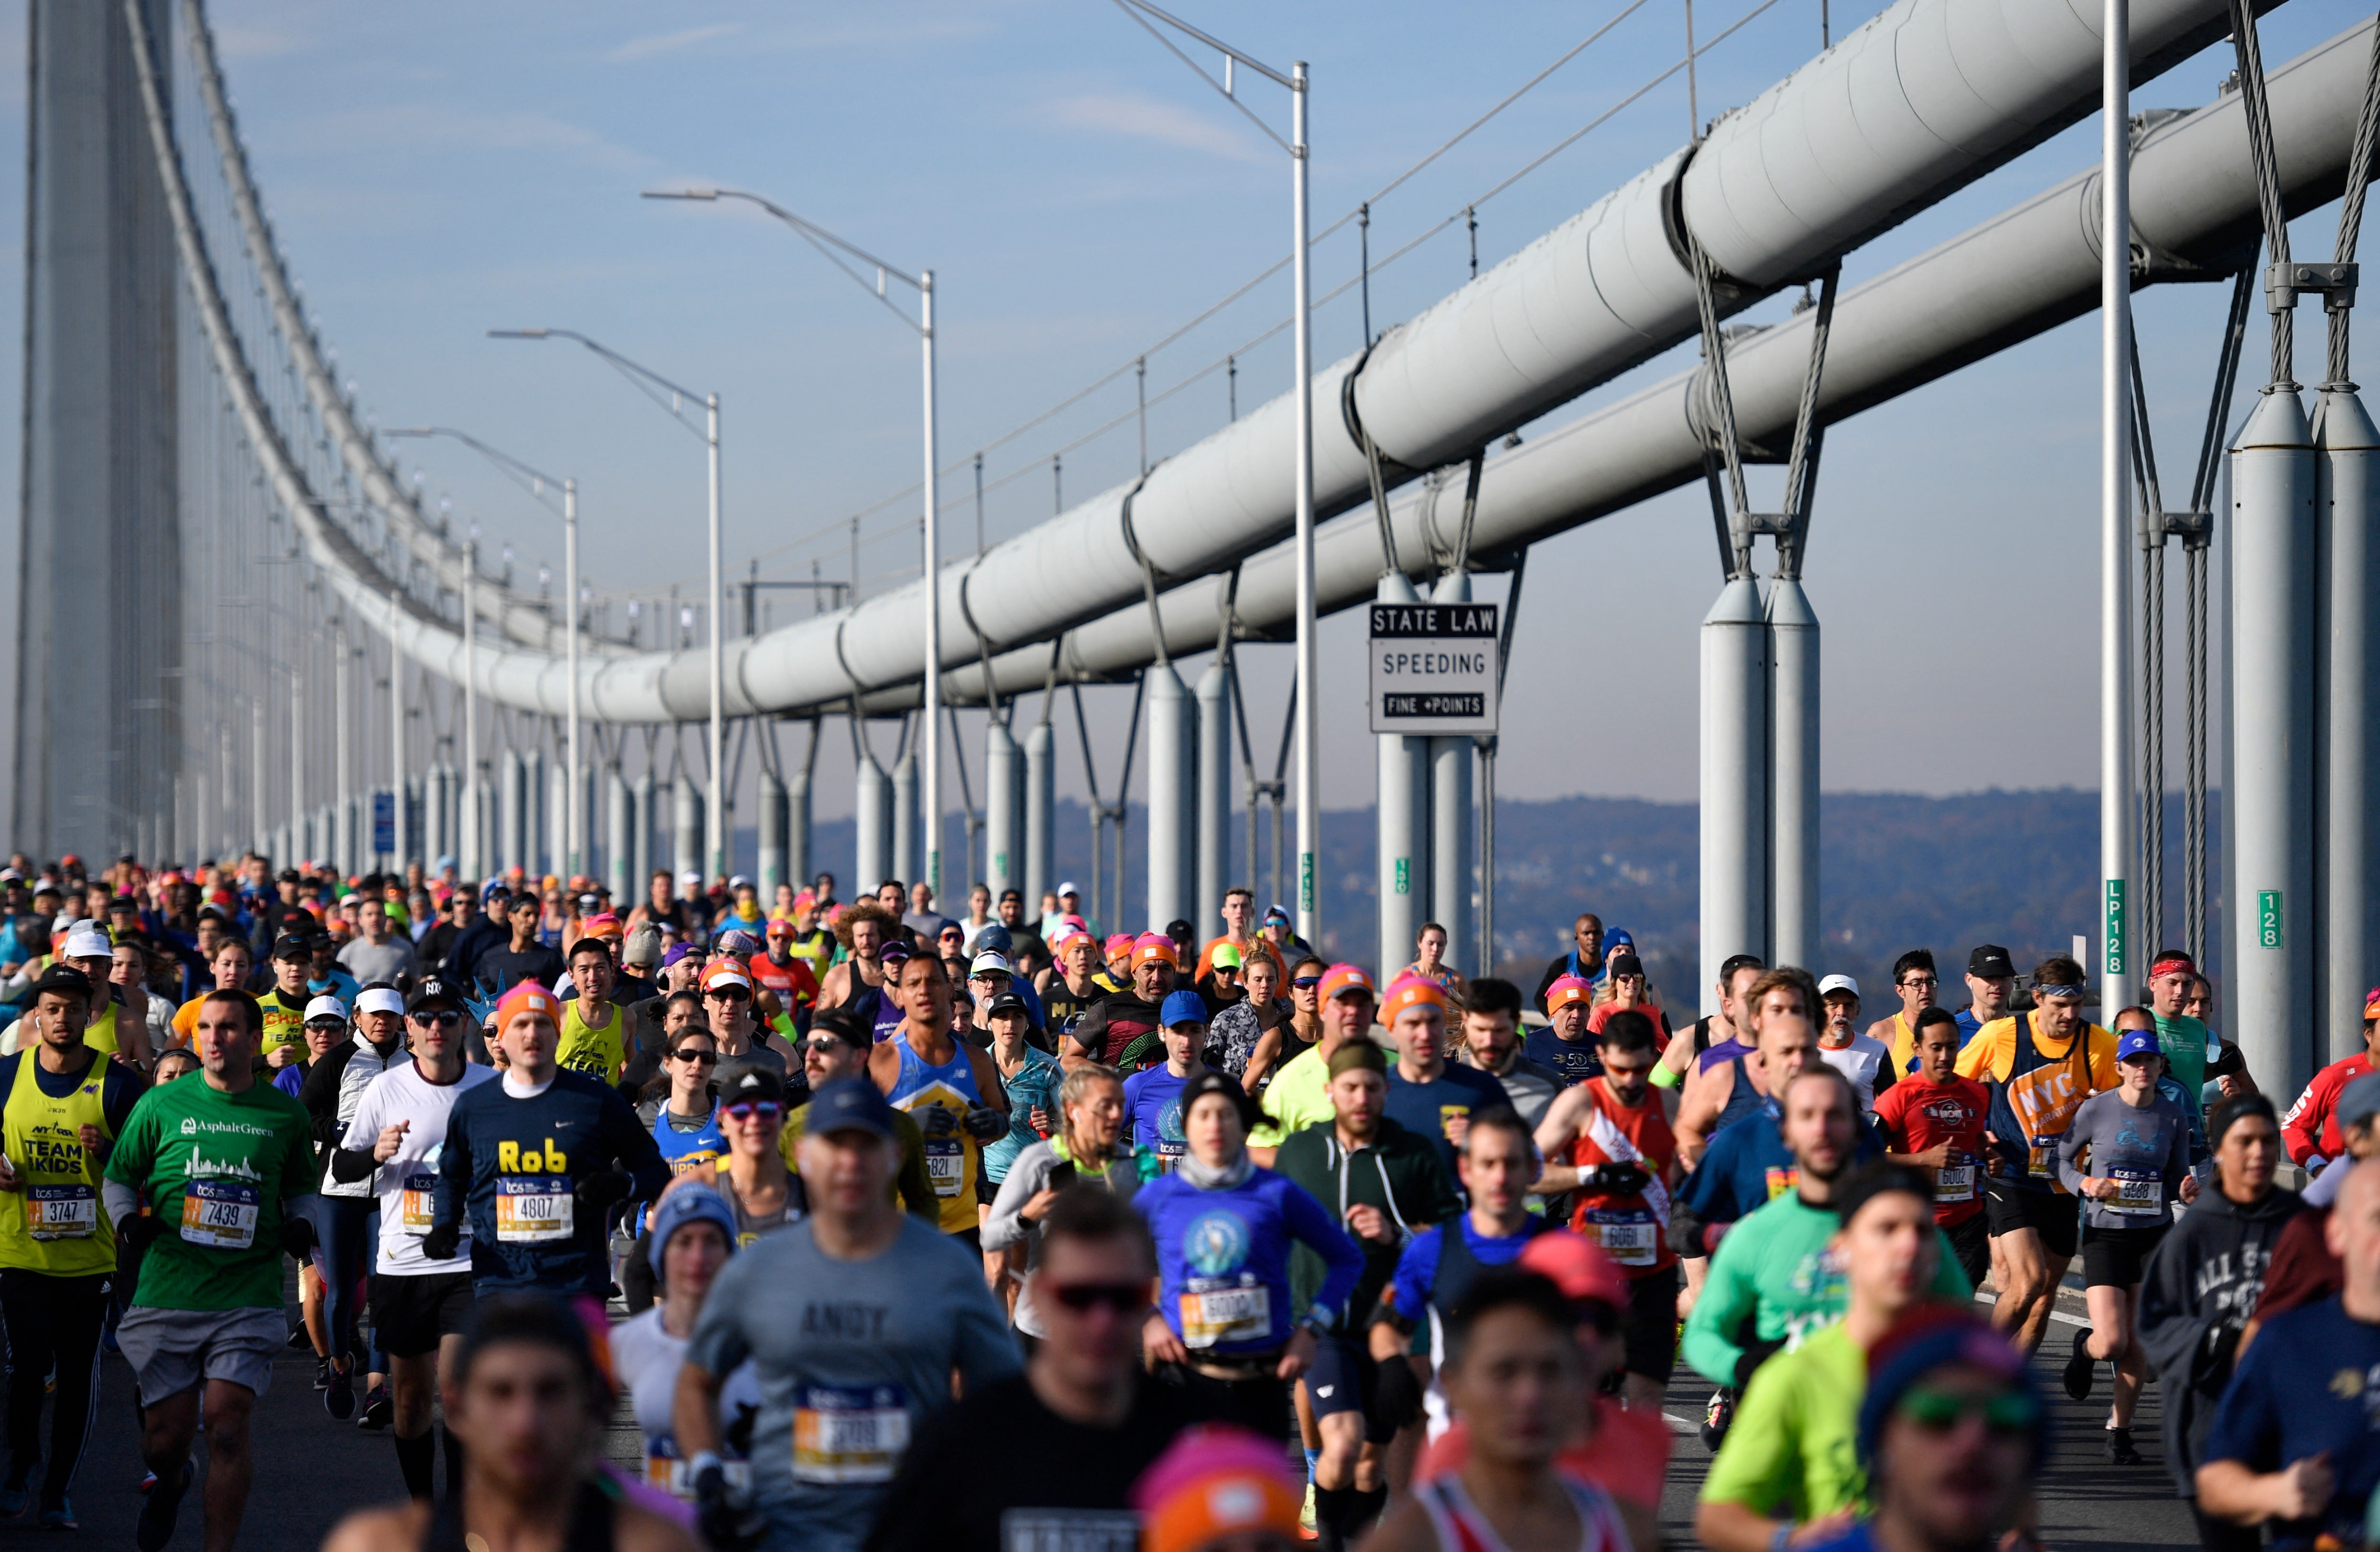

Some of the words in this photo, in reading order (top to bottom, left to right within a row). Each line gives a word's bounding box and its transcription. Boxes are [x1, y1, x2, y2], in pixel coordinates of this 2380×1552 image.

[1373, 609, 1437, 632] STATE
[1451, 610, 1494, 631] LAW
[1383, 653, 1485, 675] SPEEDING
[1388, 697, 1418, 713] FINE
[2264, 894, 2277, 945] 128
[1052, 1003, 1090, 1018] MI
[575, 1034, 608, 1051] Henry
[568, 1058, 608, 1077] TEAM
[2019, 1072, 2077, 1117] NYC
[2030, 1097, 2082, 1132] MARATHON
[25, 1140, 82, 1160] TEAM
[498, 1137, 567, 1174] Rob
[1160, 1143, 1174, 1153] tcs
[35, 1157, 82, 1174] KIDS
[414, 1177, 431, 1189] tcs
[1942, 1168, 1966, 1185] 6002
[36, 1188, 52, 1199] tcs
[197, 1183, 215, 1197] tcs
[506, 1181, 524, 1194] tcs
[2124, 1183, 2150, 1199] 5988
[50, 1202, 78, 1222] 3747
[208, 1202, 240, 1226] 7439
[521, 1197, 553, 1219] 4807
